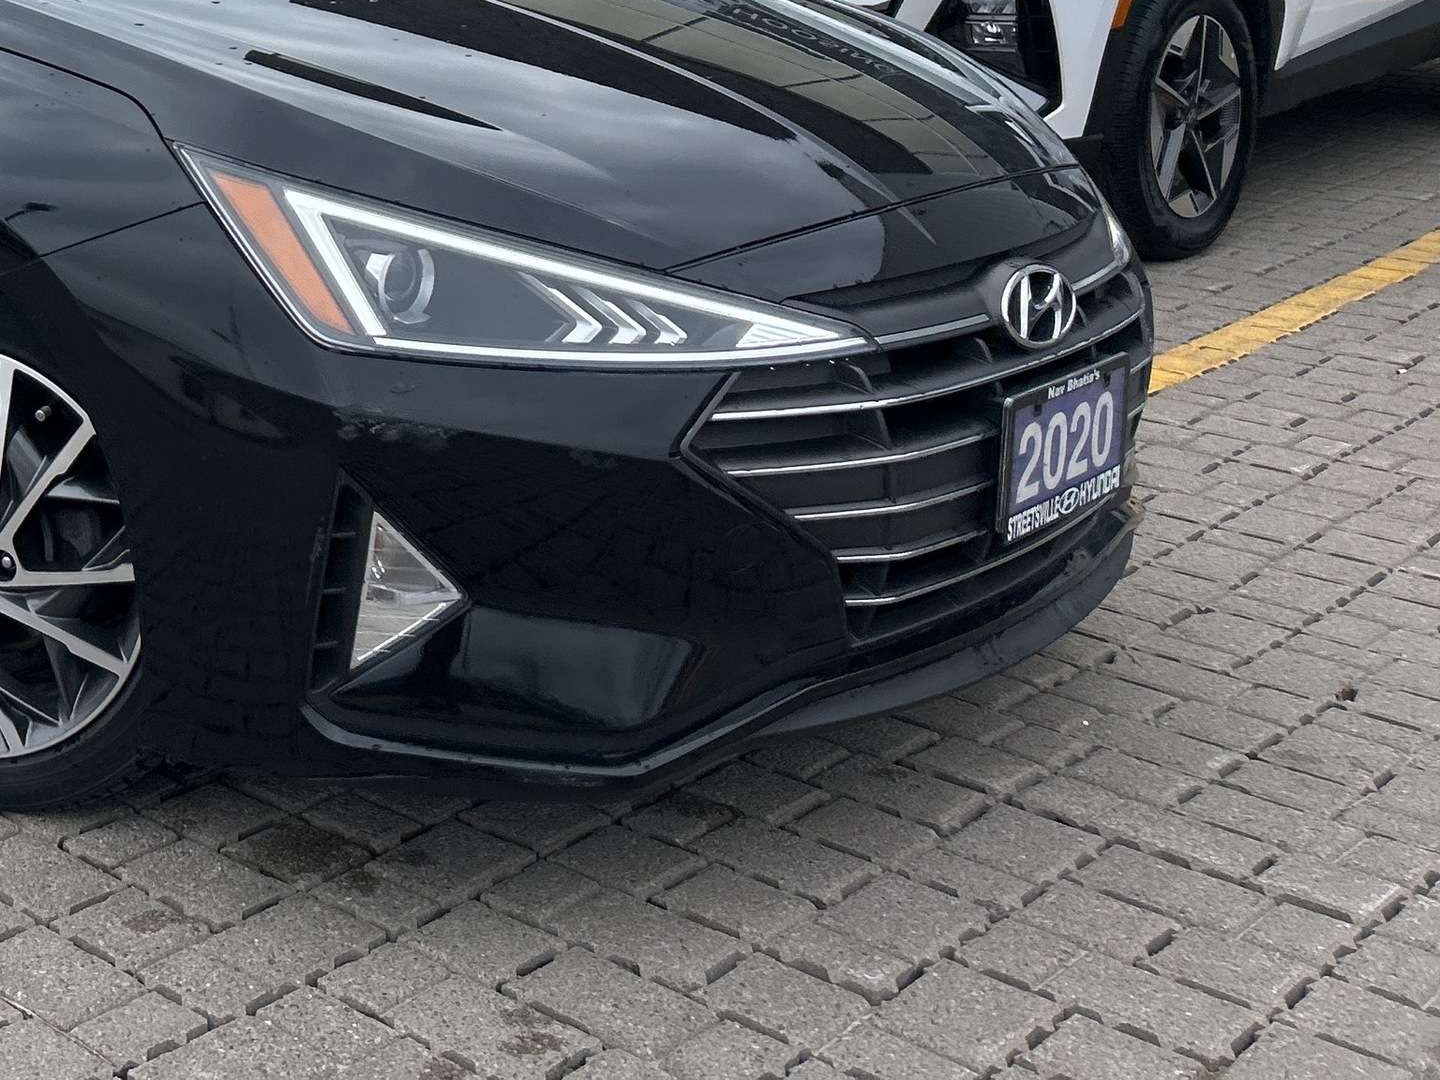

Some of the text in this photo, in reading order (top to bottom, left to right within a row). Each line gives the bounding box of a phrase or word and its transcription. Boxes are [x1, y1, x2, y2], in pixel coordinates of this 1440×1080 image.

[1048, 369, 1100, 399] Nav Bhatia's
[1016, 391, 1113, 504] 2020
[1007, 464, 1120, 541] STREETSVILLE HYUNDAI
